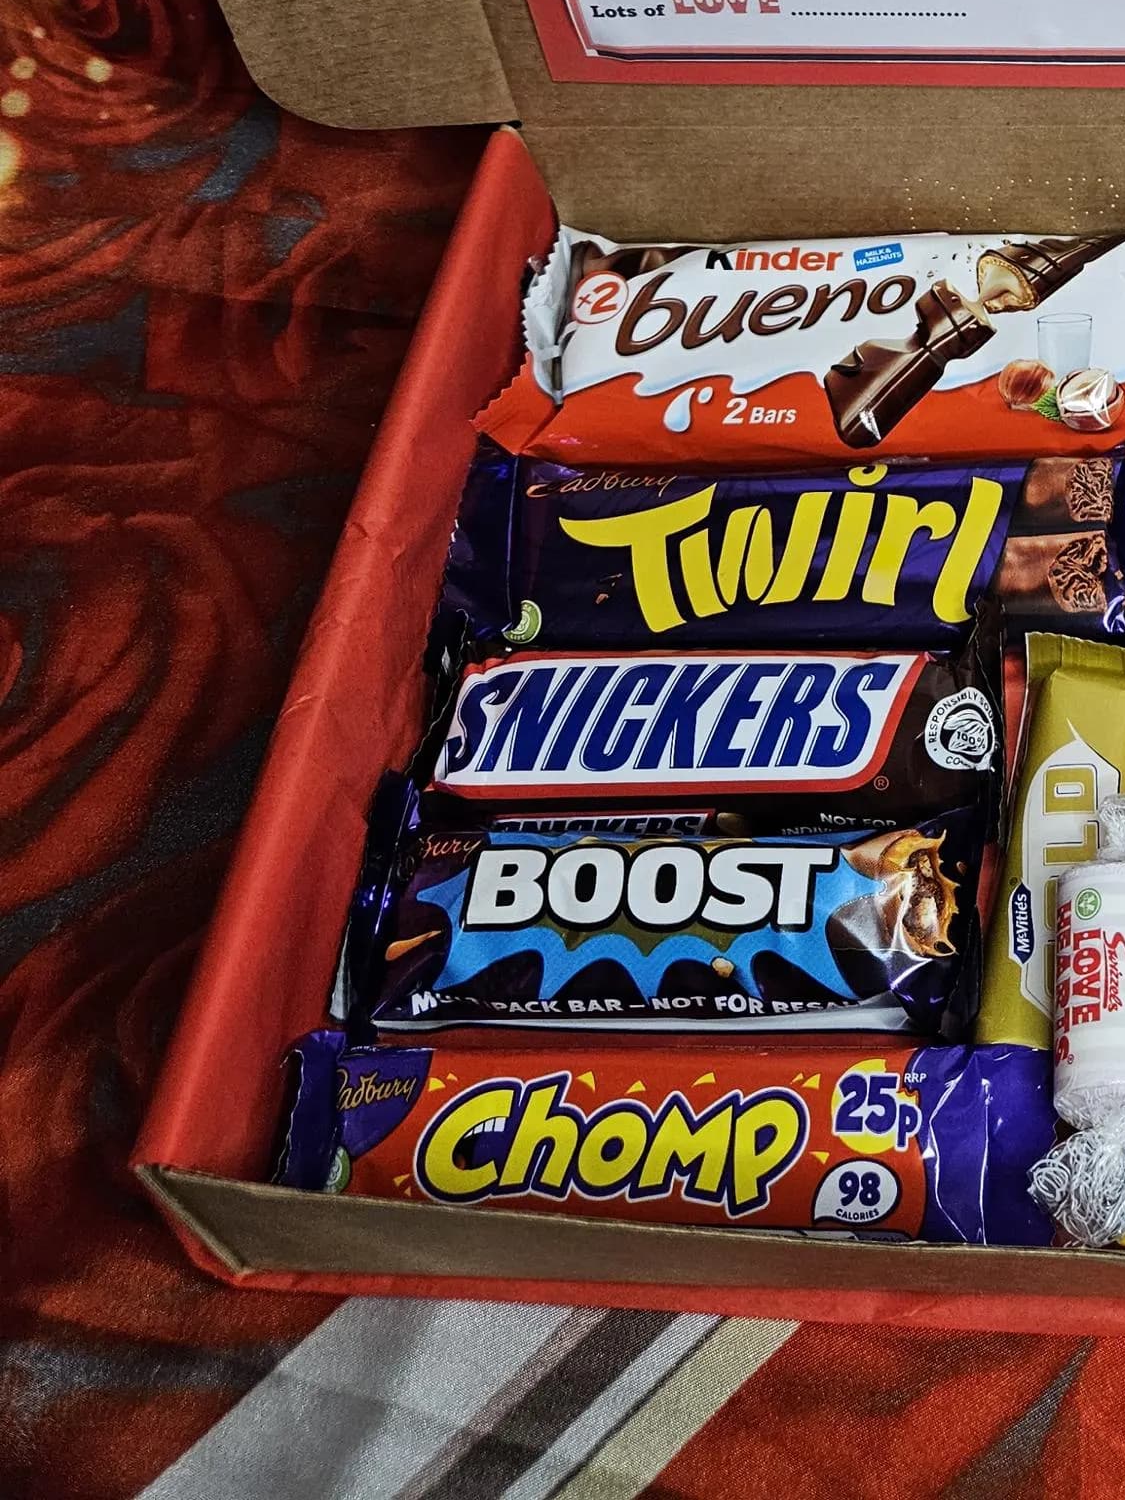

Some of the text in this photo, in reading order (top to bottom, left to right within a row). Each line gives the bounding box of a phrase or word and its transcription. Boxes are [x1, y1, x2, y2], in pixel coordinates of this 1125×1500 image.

[589, 5, 638, 19] Lots
[643, 3, 666, 18] of
[705, 247, 843, 272] Kinder
[856, 251, 902, 267] HAZELNUTS
[615, 272, 917, 357] bueno
[722, 397, 796, 425] 2 Bars
[558, 464, 1003, 633] Twirl
[444, 661, 901, 774] SNICKERS
[957, 730, 986, 750] 100%
[466, 846, 835, 927] BOOST
[1072, 928, 1102, 1027] LOVE
[567, 999, 625, 1012] BAR
[651, 996, 707, 1010] NOT
[714, 993, 765, 1014] FOR
[771, 1000, 862, 1013] RESA
[834, 1072, 927, 1149] 25p RRP
[838, 1170, 881, 1207] 98
[835, 1208, 879, 1222] CALORIES
